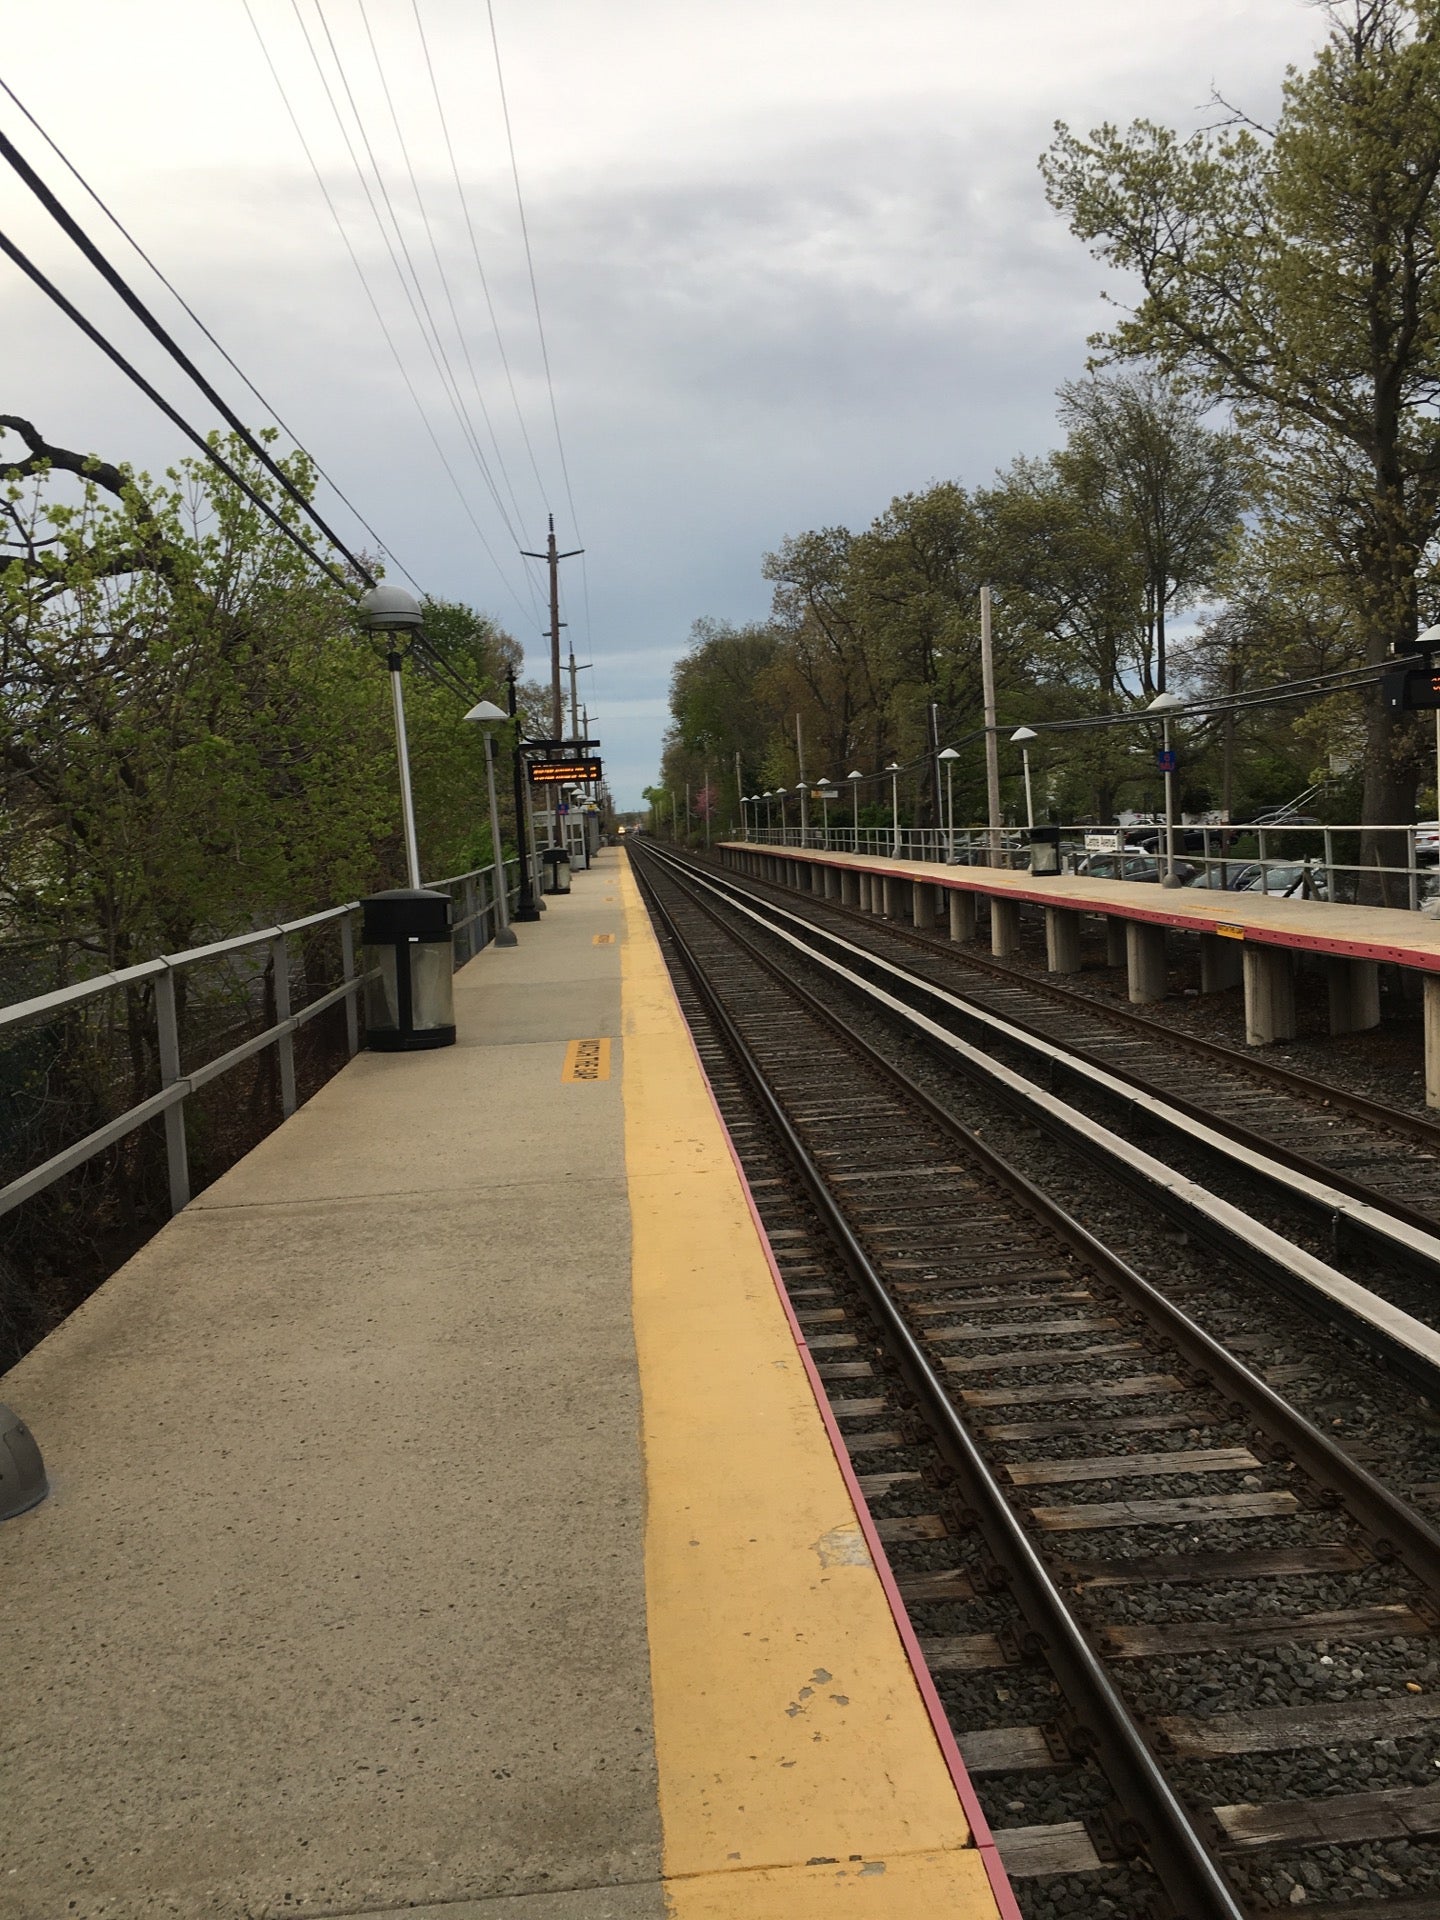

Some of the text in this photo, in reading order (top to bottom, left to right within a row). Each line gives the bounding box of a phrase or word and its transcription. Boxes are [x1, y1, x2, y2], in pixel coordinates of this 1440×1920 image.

[573, 1040, 600, 1080] WATCH THE GAP
